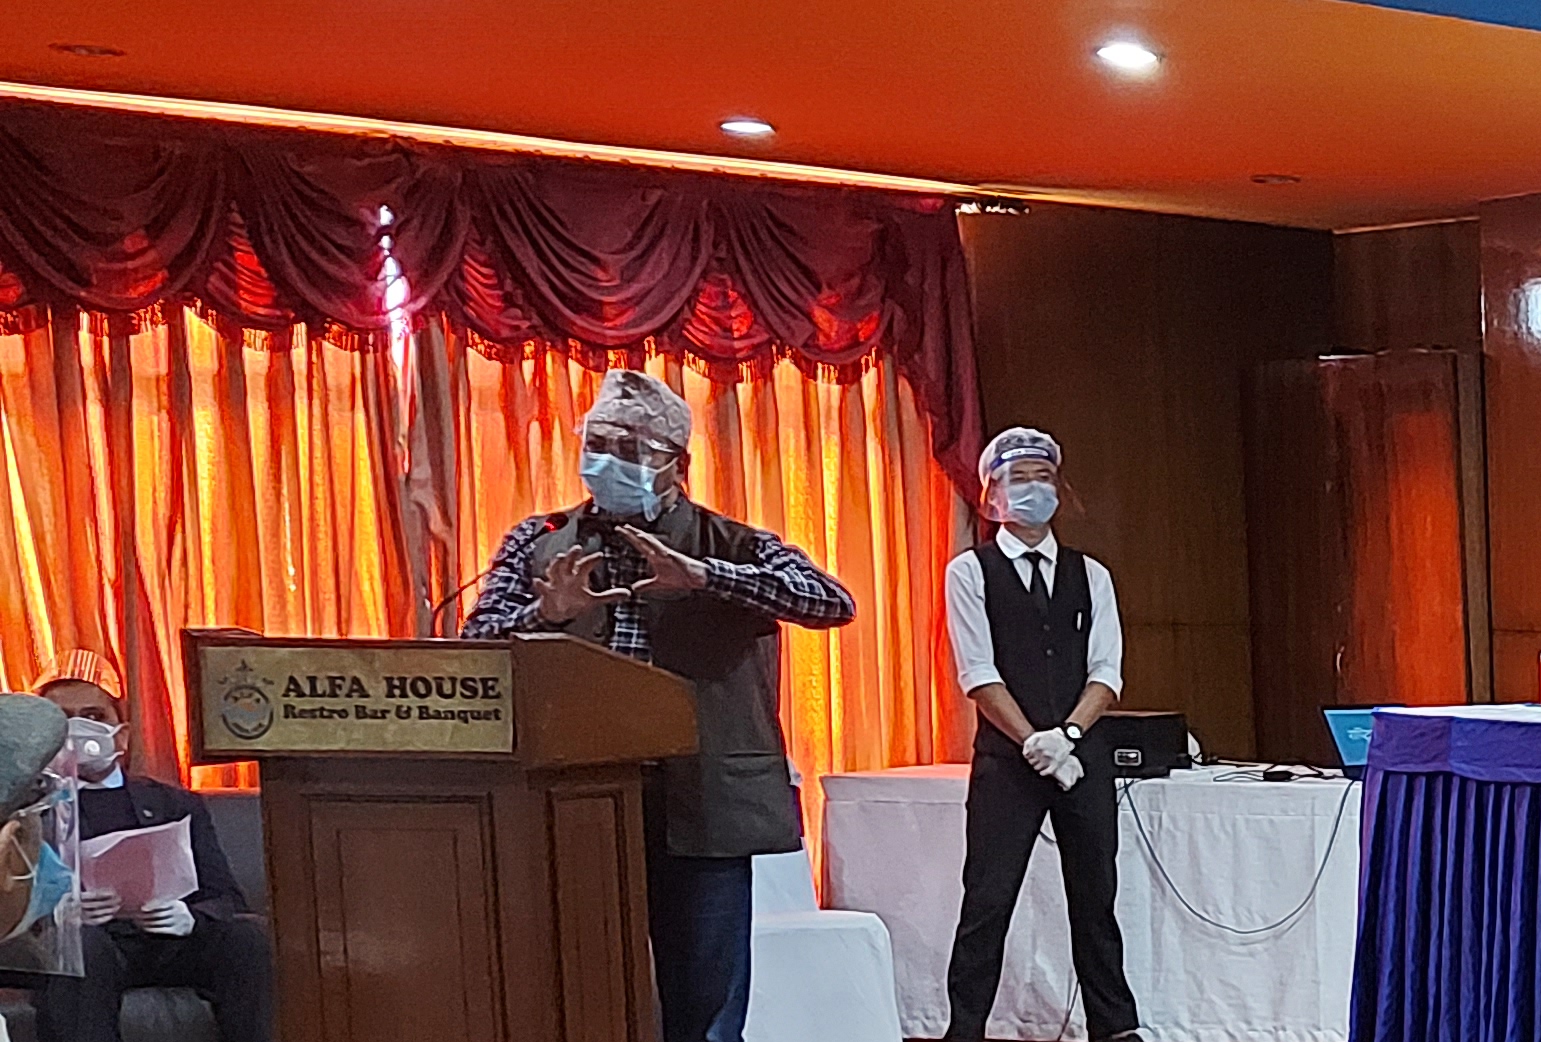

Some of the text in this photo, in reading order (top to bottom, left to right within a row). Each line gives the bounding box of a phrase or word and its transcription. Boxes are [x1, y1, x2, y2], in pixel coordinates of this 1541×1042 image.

[282, 675, 502, 699] ALFA HOUSE
[283, 704, 502, 724] Restro Bar & Banquet
